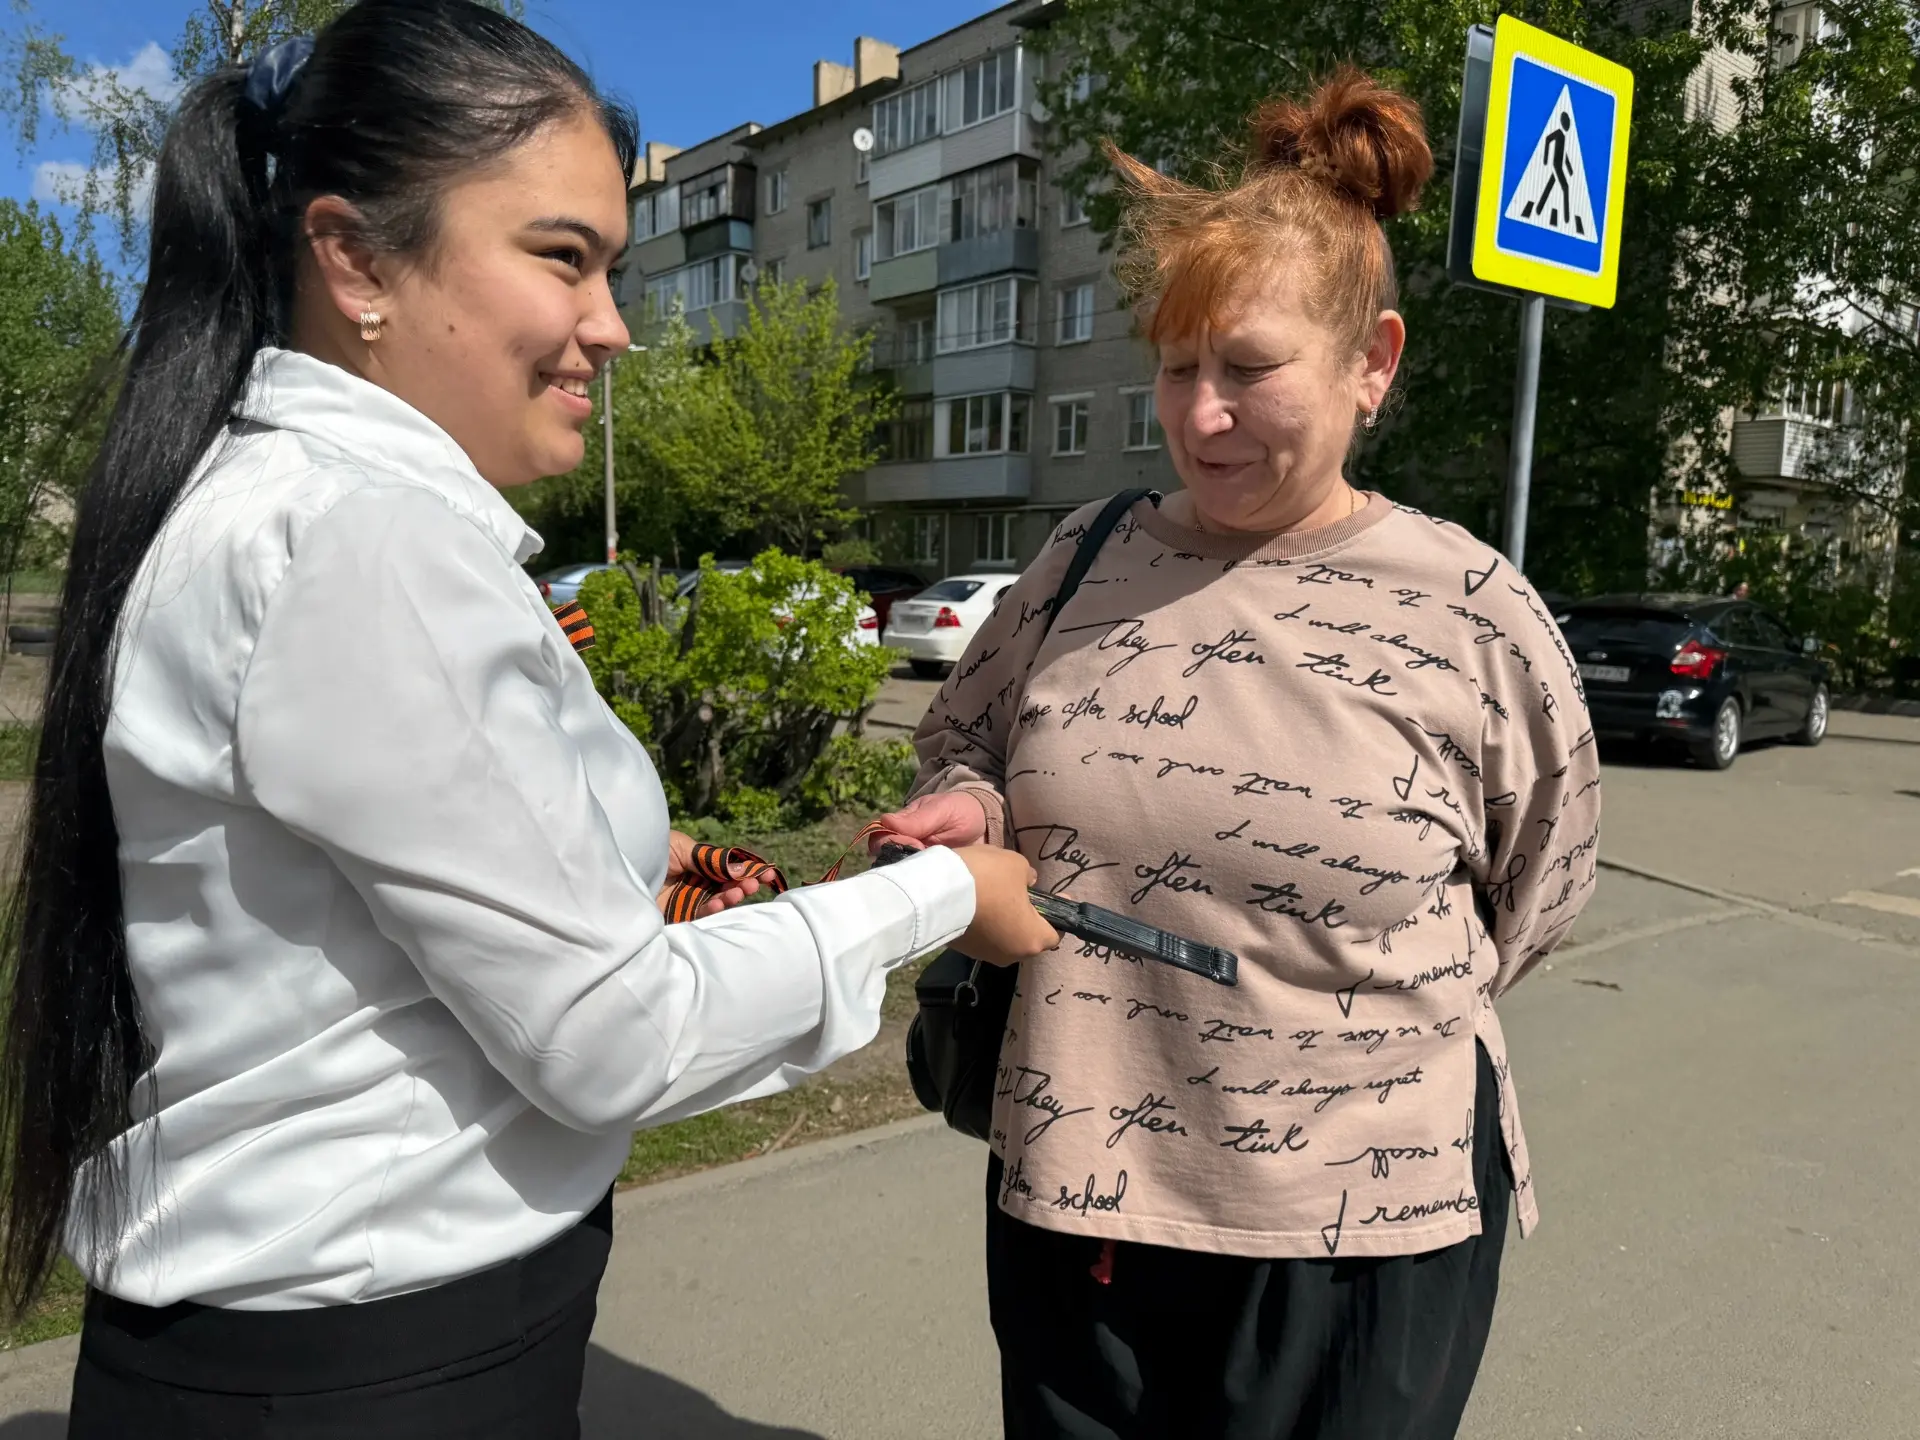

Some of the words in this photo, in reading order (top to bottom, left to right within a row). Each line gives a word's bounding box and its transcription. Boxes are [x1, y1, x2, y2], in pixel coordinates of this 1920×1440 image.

[1296, 563, 1374, 589] wait
[1389, 589, 1432, 607] to
[1059, 618, 1178, 677] They
[1182, 629, 1266, 678] often
[1296, 652, 1397, 696] tink
[1370, 634, 1460, 673] always
[1062, 687, 1106, 730] after
[1118, 695, 1199, 730] school
[1157, 758, 1225, 779] and
[1232, 772, 1312, 798] wait
[1329, 797, 1373, 819] to
[1015, 824, 1120, 893] They
[1131, 850, 1213, 905] often
[1246, 883, 1349, 930] tink
[1320, 855, 1410, 896] always
[1373, 958, 1473, 992] remembe
[1126, 998, 1189, 1021] and
[1198, 1019, 1274, 1043] wait
[1288, 1030, 1324, 1052] to
[1337, 1029, 1390, 1055] have
[1015, 1066, 1095, 1145] They
[1107, 1092, 1189, 1149] often
[1219, 1119, 1309, 1154] tink
[1280, 1079, 1356, 1113] always
[1050, 1169, 1128, 1216] school
[1359, 1188, 1478, 1225] remembe
